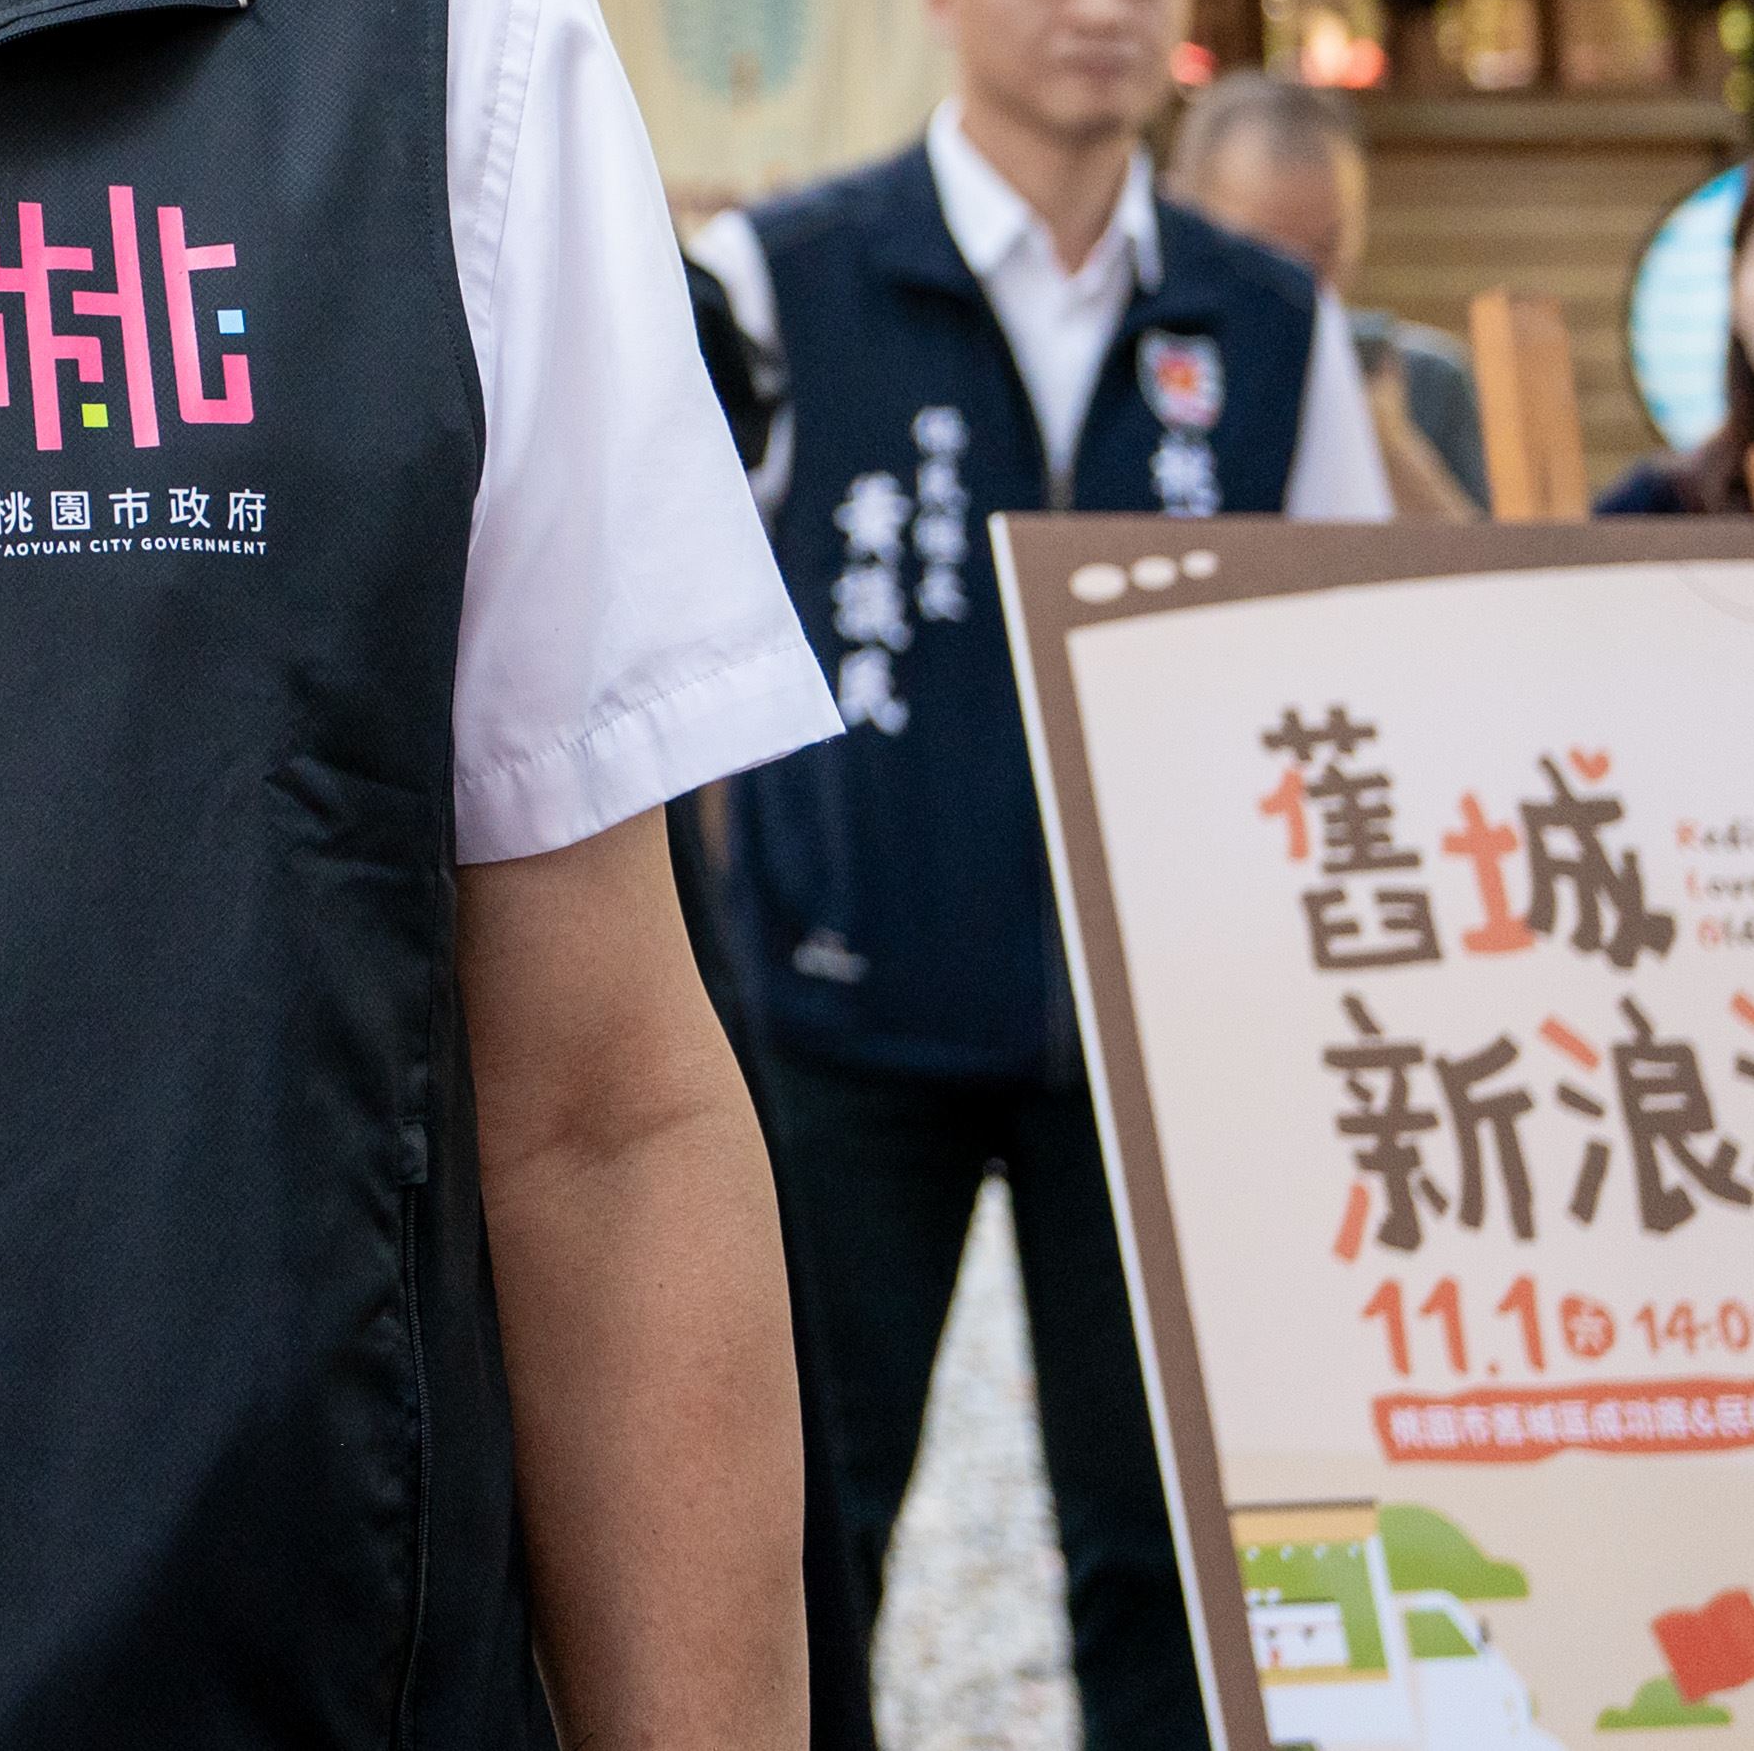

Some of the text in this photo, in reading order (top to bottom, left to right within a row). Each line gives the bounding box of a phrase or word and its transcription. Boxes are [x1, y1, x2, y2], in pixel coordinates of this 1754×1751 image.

[89, 538, 132, 553] CITY
[141, 537, 267, 555] GOVERNMENT
[1258, 705, 1678, 969] 舊城
[1323, 991, 1754, 1263] 新浪
[1361, 1274, 1547, 1377] 11.1
